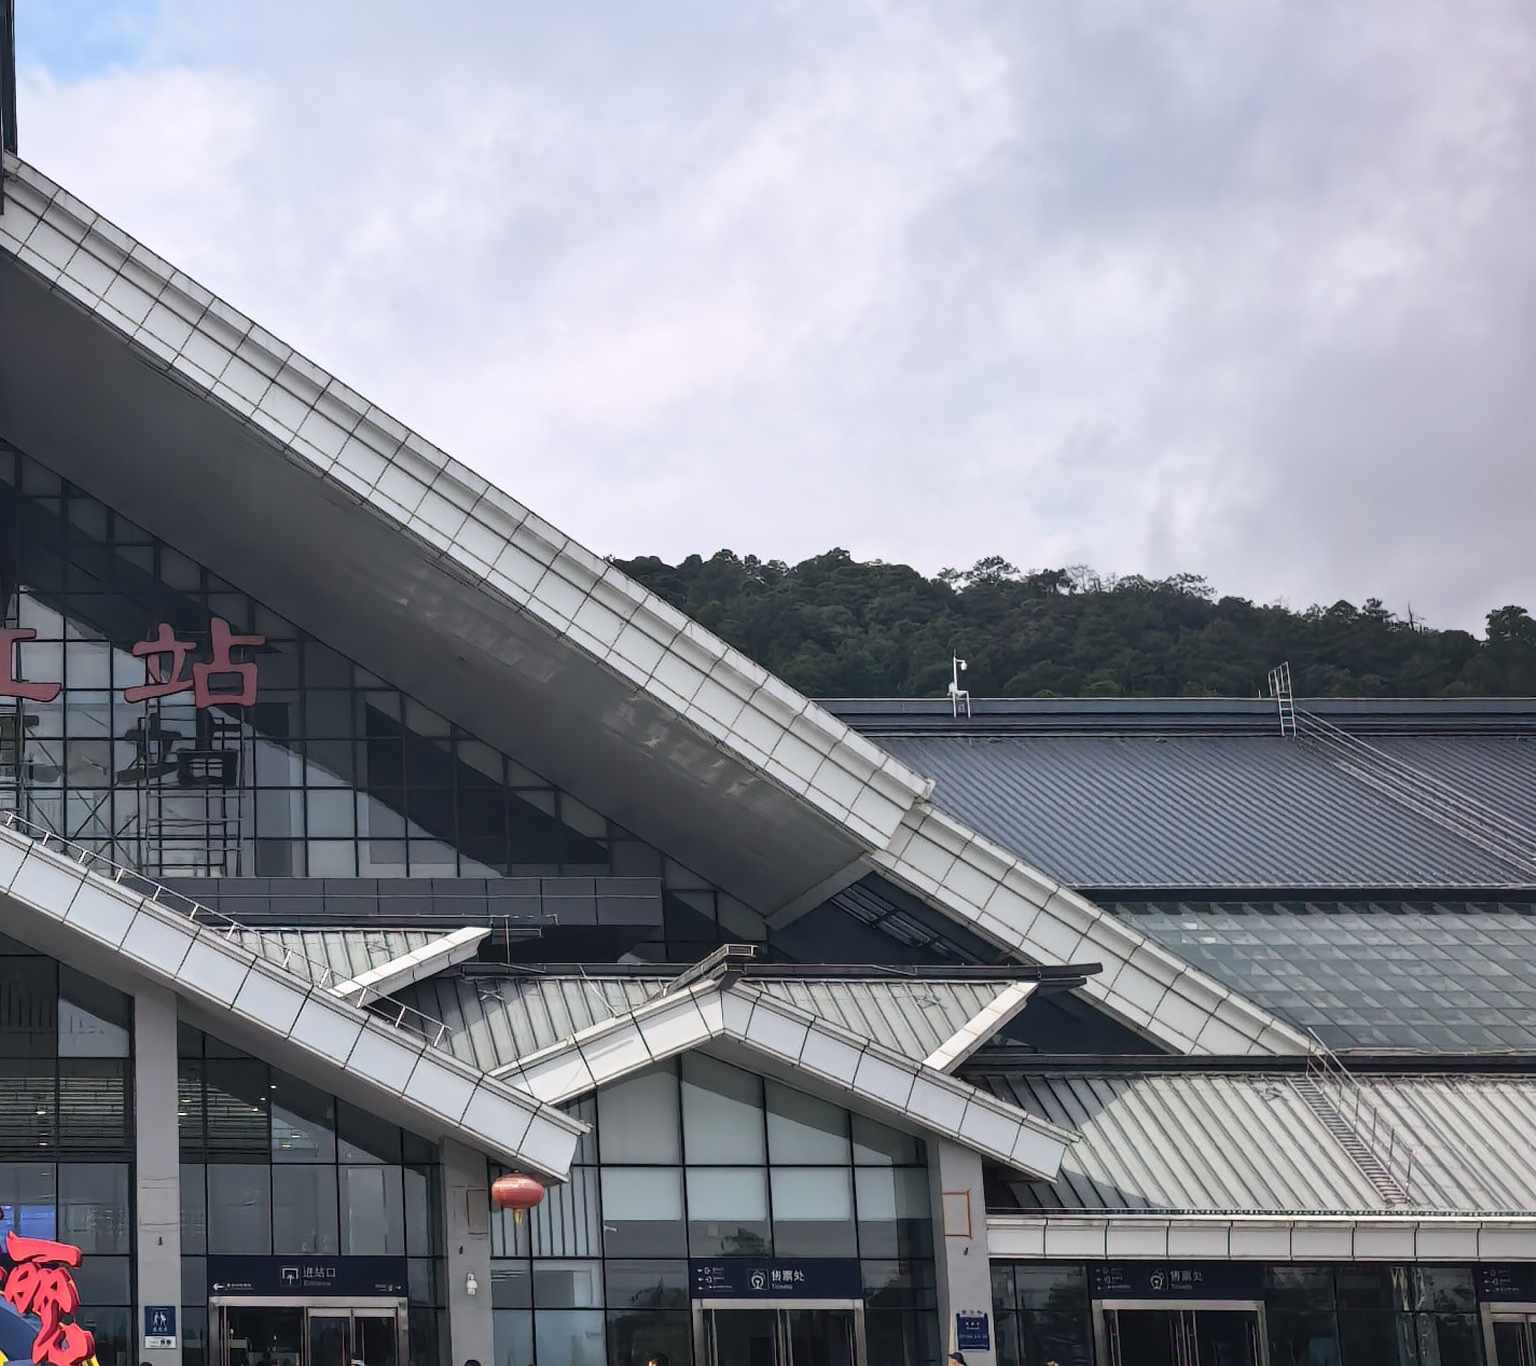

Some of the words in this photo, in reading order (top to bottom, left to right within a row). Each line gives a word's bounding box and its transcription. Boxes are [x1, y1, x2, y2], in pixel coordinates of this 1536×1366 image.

[302, 1265, 336, 1278] 进站口
[771, 1269, 805, 1282] 售票处
